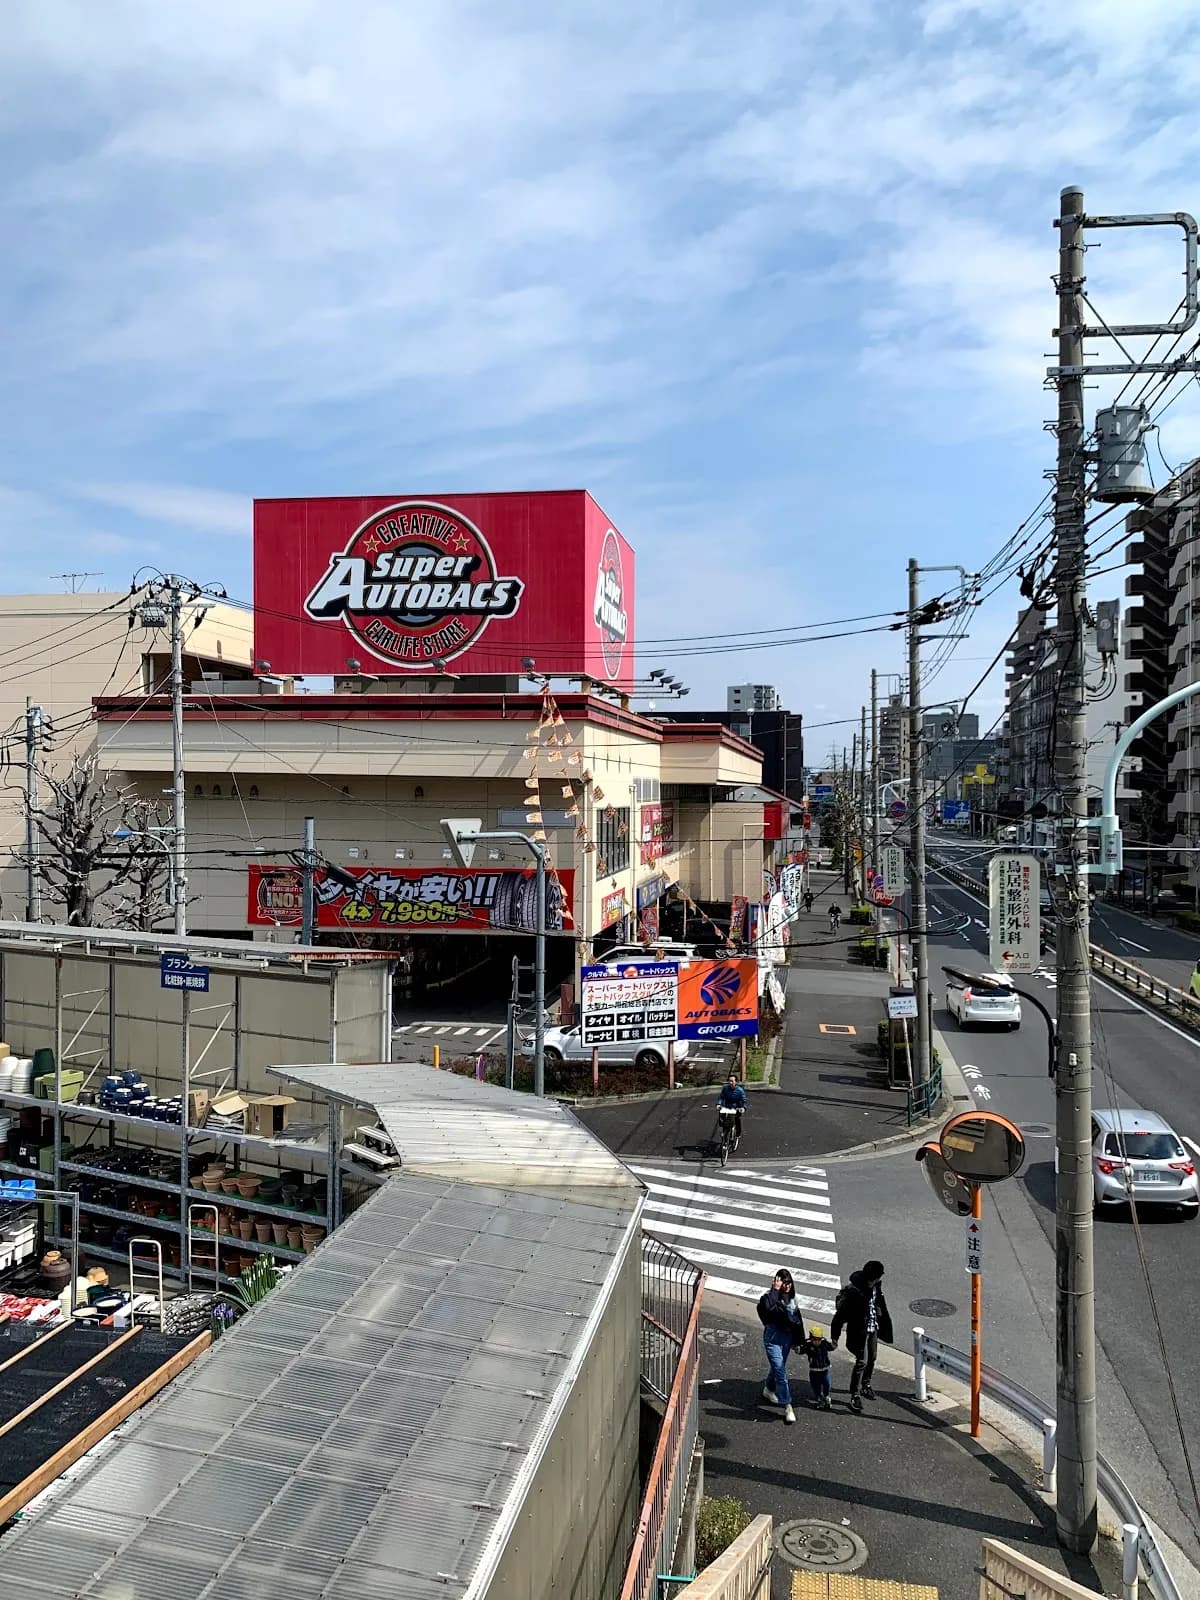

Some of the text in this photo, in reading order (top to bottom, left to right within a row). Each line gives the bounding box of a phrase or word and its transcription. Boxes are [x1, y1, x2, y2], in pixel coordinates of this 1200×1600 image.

[375, 514, 457, 545] CREATIVE
[371, 552, 474, 582] Super
[309, 557, 513, 611] AUTOBACS
[364, 618, 469, 657] CARLIFE STORE
[1006, 859, 1022, 945] 鳥居整形外科
[341, 901, 373, 920] 4本
[639, 966, 676, 976] オートバックス
[587, 981, 674, 993] スーパーオートバックスは
[619, 1014, 642, 1024] オイル
[648, 1012, 674, 1021] バッテリー
[684, 1007, 752, 1019] AUTOBACS
[588, 1016, 612, 1026] タイヤ
[621, 1029, 640, 1039] 車検
[697, 1024, 740, 1035] GROUP
[587, 1031, 613, 1041] カーナビ
[967, 1236, 981, 1270] 注意
